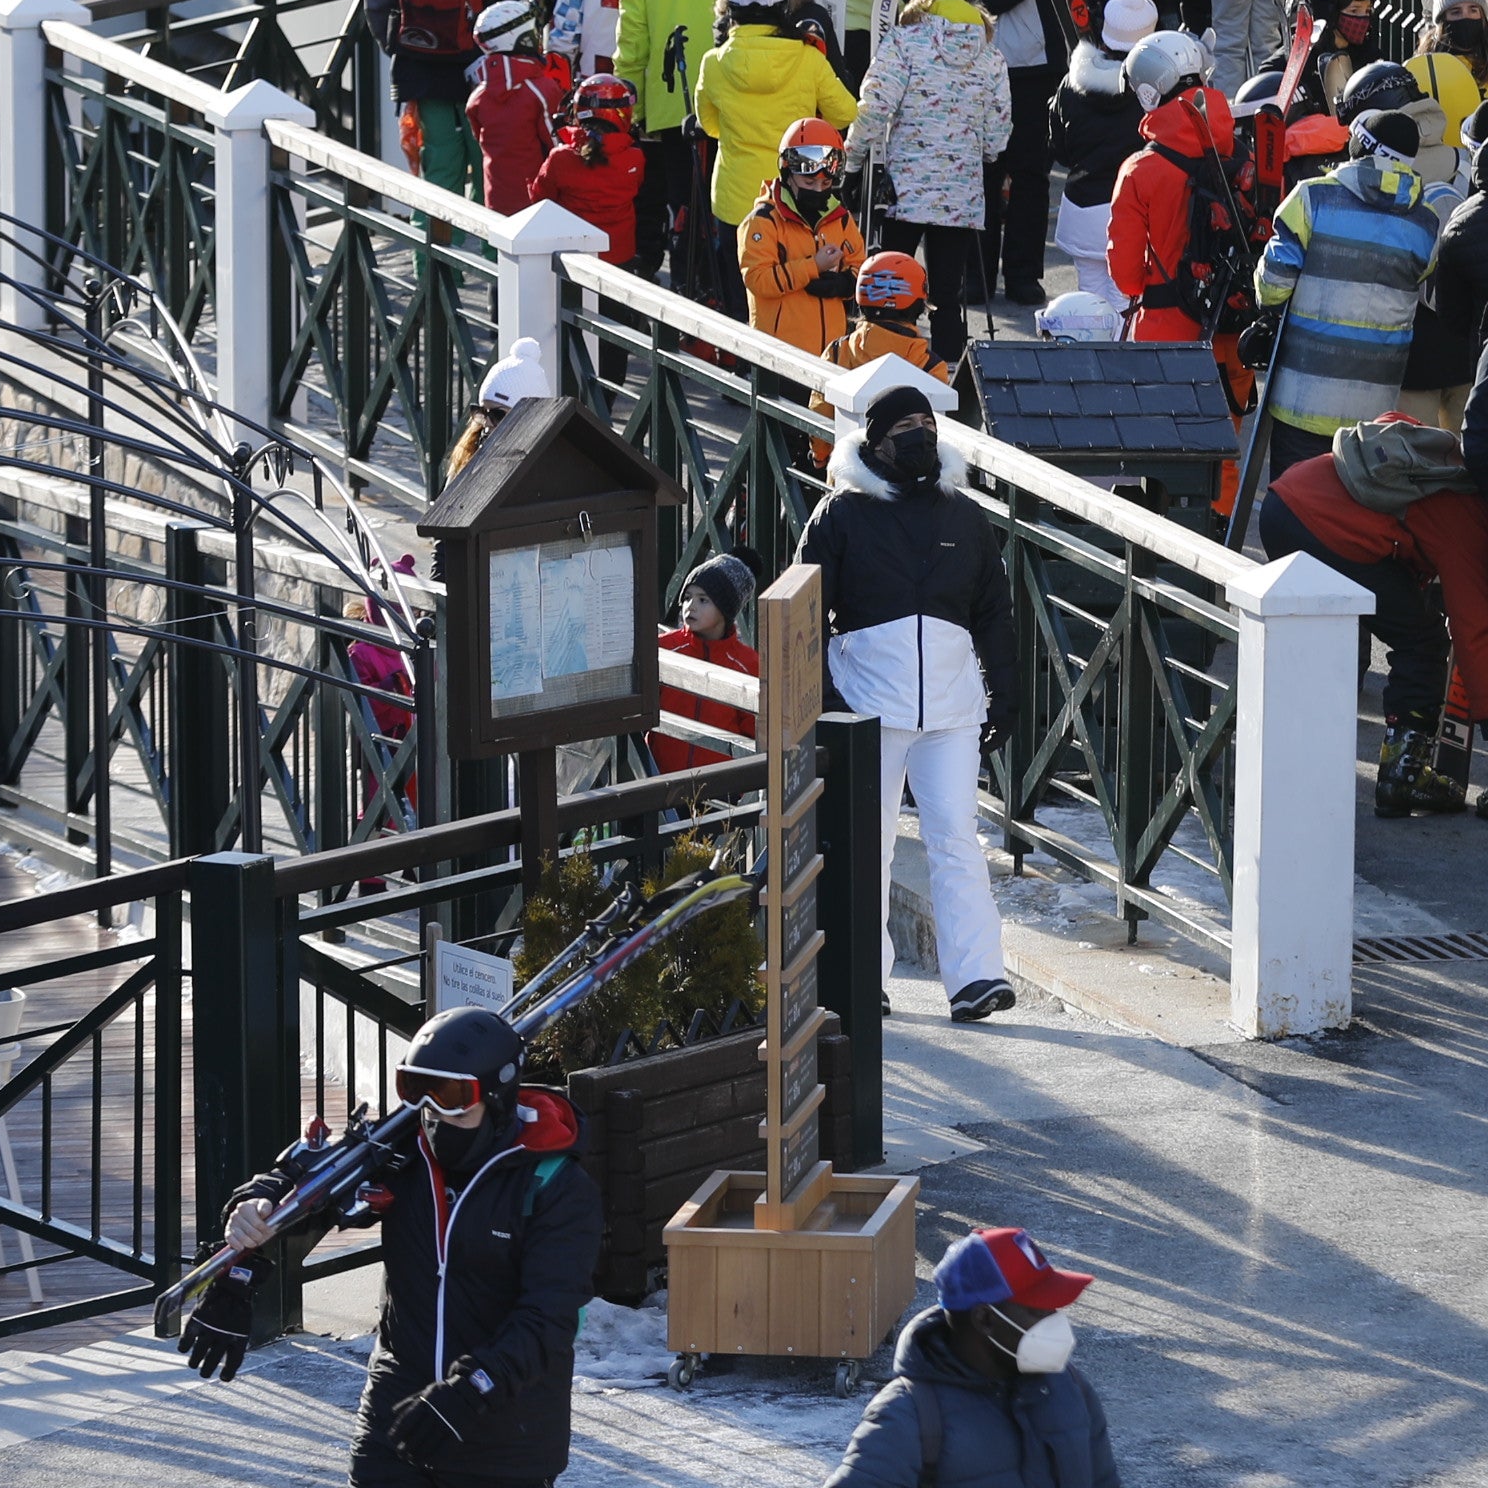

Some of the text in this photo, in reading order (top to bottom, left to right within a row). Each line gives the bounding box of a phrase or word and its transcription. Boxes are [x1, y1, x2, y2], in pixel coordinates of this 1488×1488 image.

[452, 962, 469, 976] Utilice
[451, 978, 460, 989] tire
[461, 980, 469, 992] las
[469, 984, 485, 997] colillas
